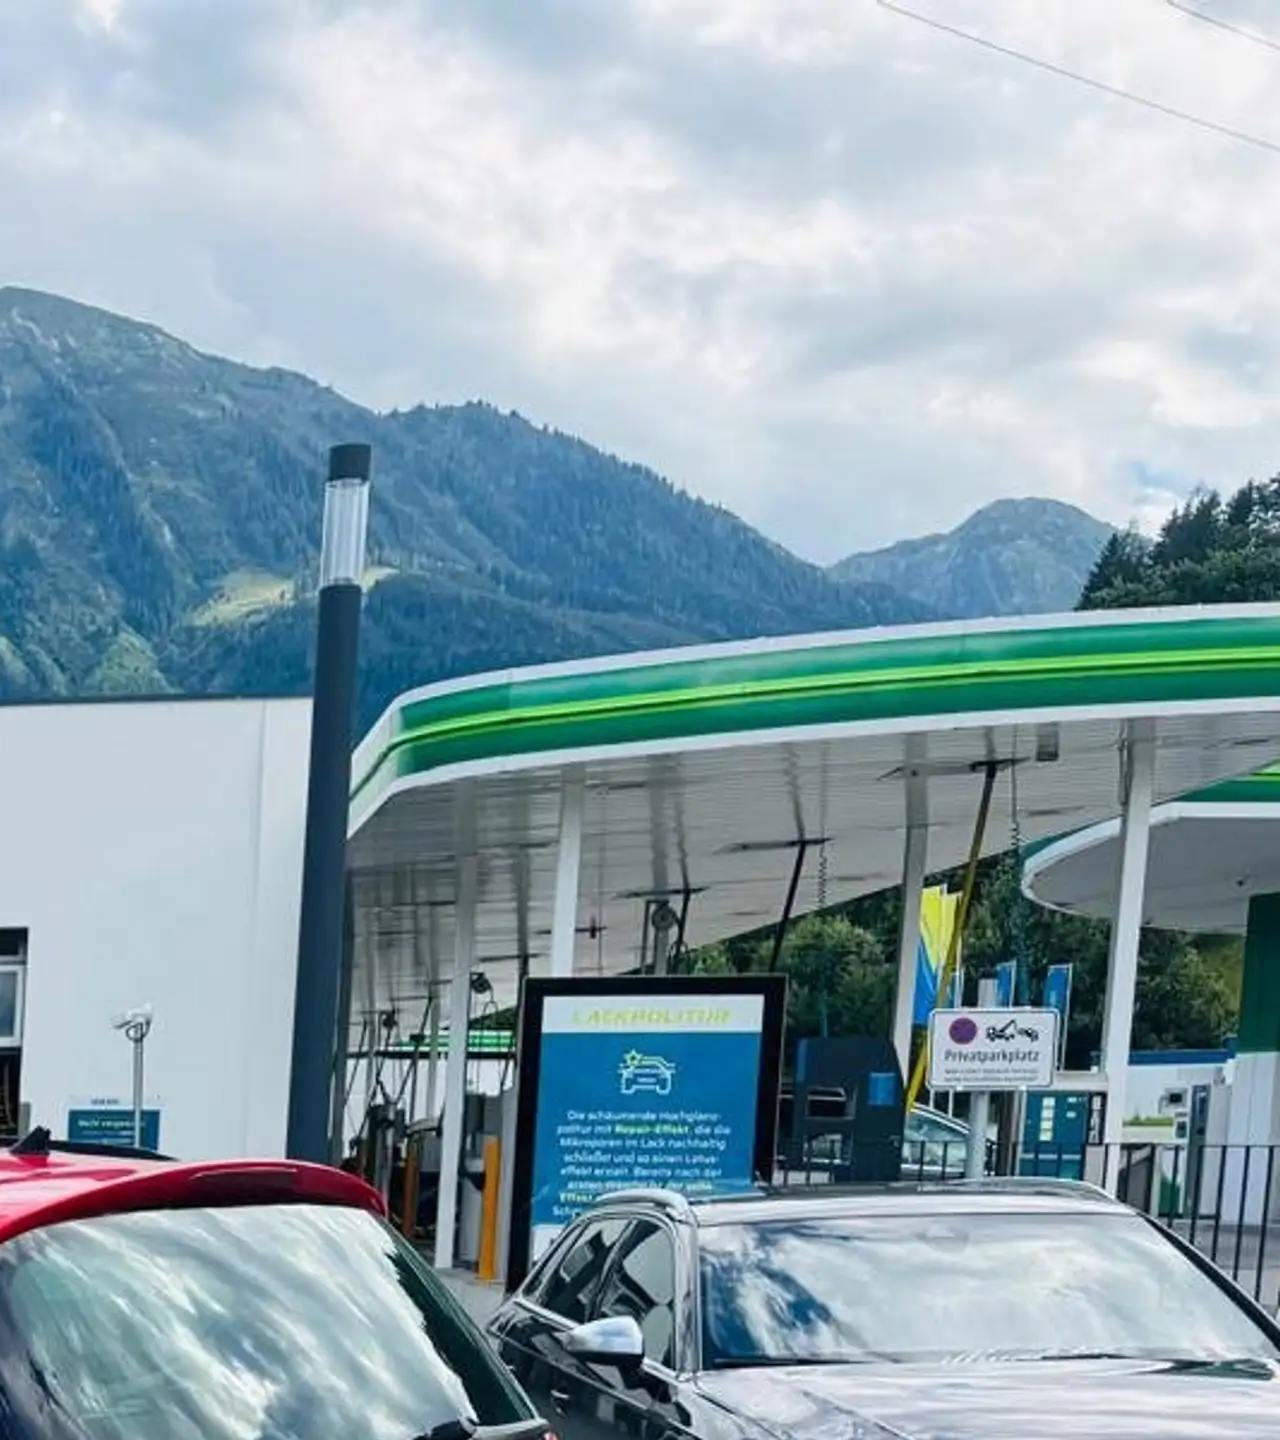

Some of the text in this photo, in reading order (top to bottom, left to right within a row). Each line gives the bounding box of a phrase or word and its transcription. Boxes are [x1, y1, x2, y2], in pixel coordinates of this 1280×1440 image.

[572, 1008, 732, 1025] LACKPOLITUR
[944, 1049, 1040, 1064] Privatparkplatz
[613, 1152, 635, 1163] und
